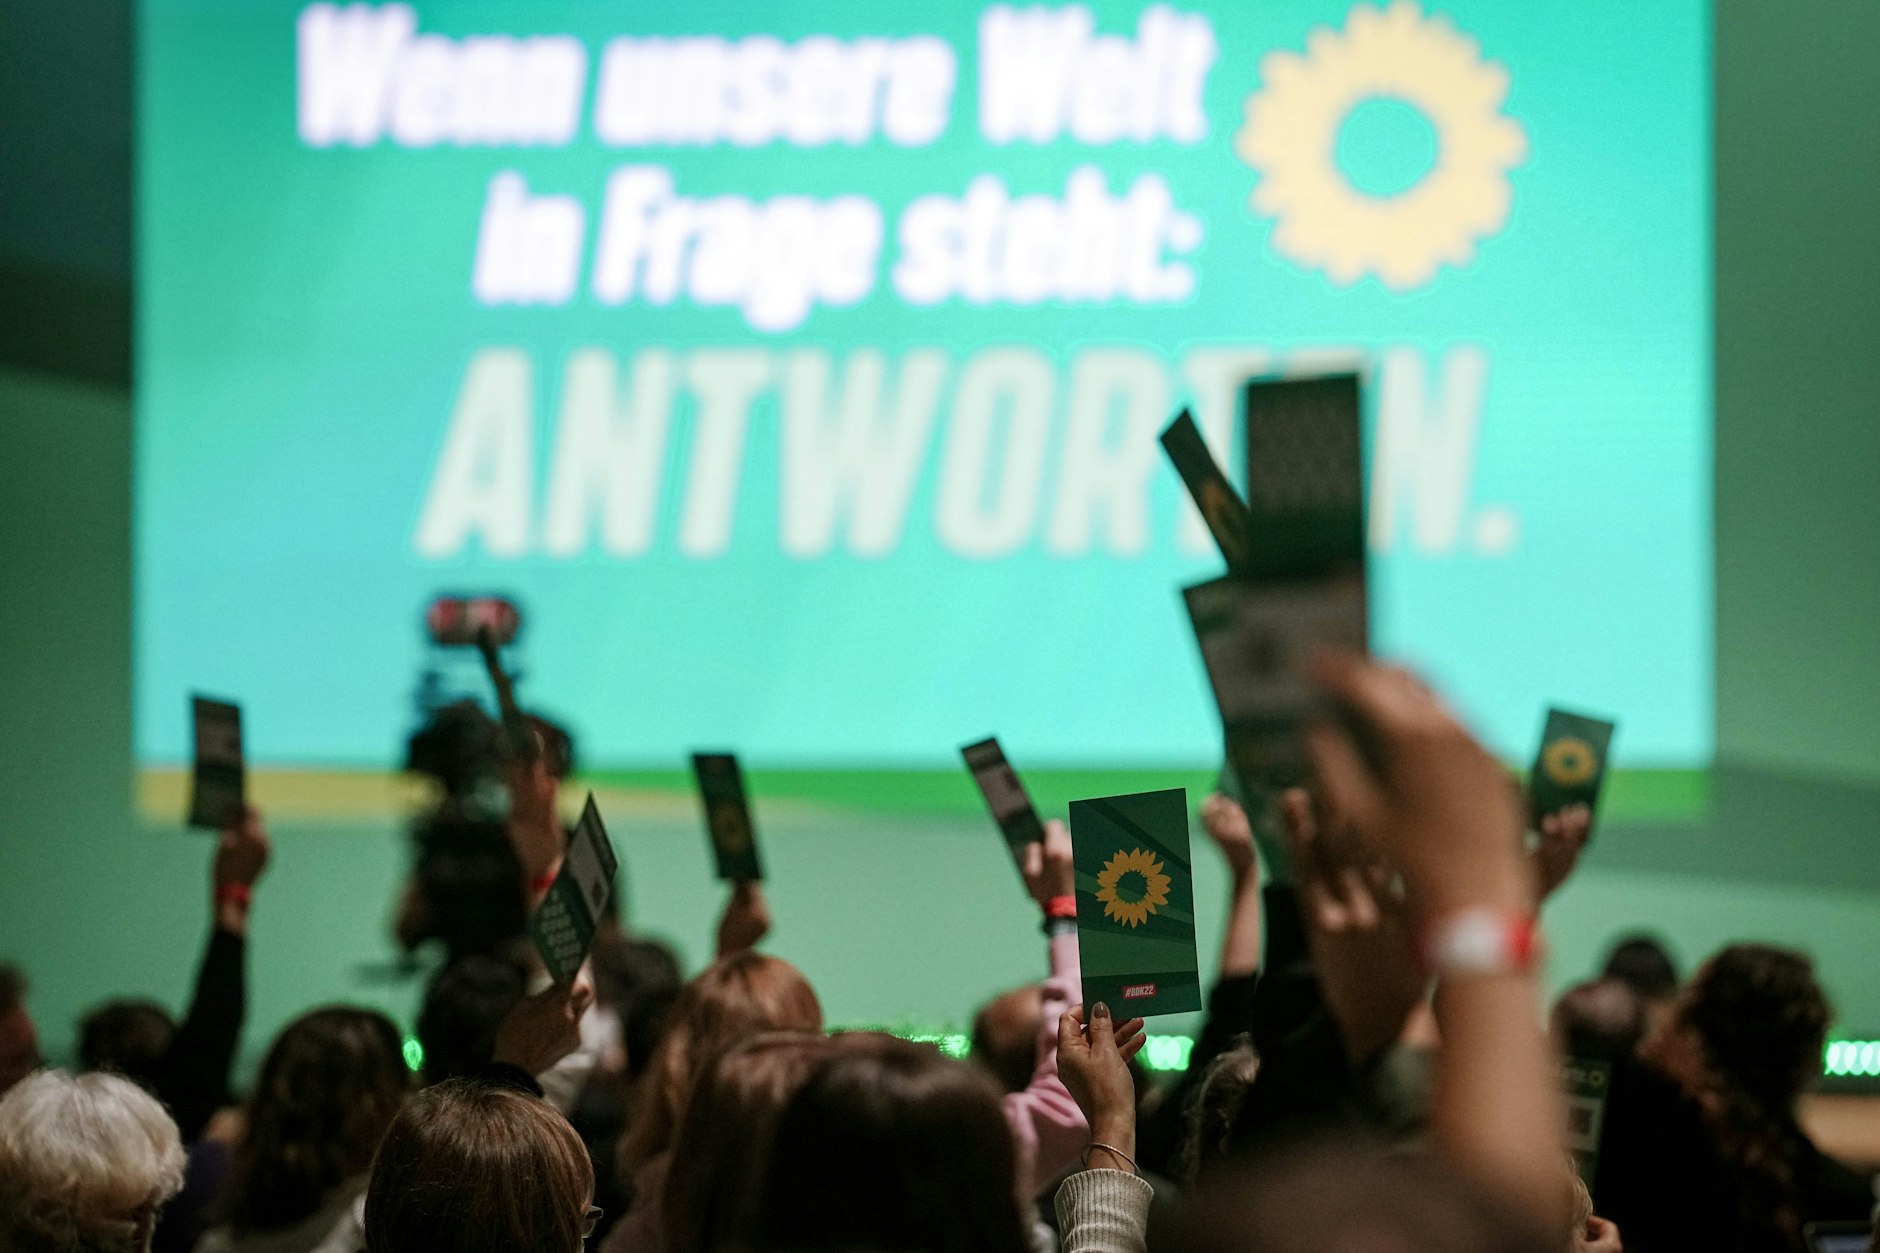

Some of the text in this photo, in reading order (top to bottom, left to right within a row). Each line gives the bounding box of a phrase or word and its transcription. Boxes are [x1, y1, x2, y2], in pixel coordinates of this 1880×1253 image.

[299, 6, 1217, 146] Wenn unsere Welt
[593, 165, 884, 332] Frage
[892, 164, 1204, 305] steht:
[416, 346, 1520, 558] ANTWORTN.
